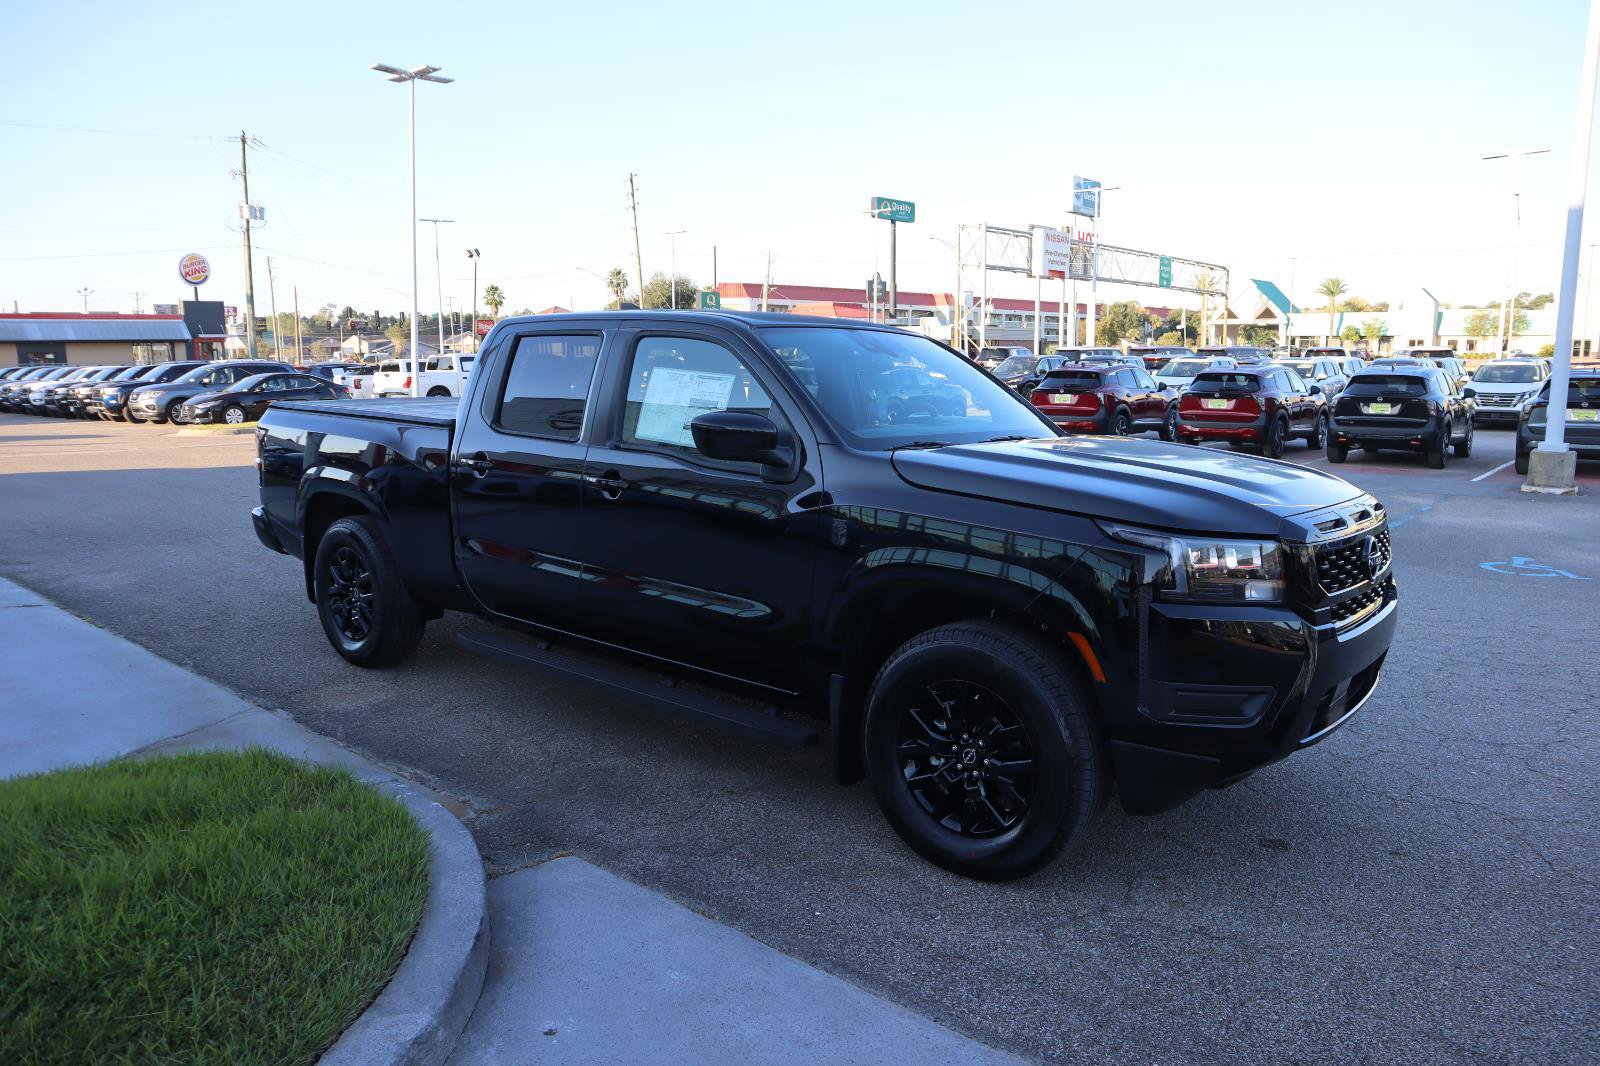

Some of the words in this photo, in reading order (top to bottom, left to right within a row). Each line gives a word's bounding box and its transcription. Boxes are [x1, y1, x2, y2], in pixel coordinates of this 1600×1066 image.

[892, 201, 912, 213] Quality
[1045, 233, 1069, 244] NISSAN
[1045, 249, 1068, 258] Pre-Owned
[183, 260, 206, 269] BURGER
[1048, 258, 1065, 266] Vehicles
[184, 266, 207, 278] KING
